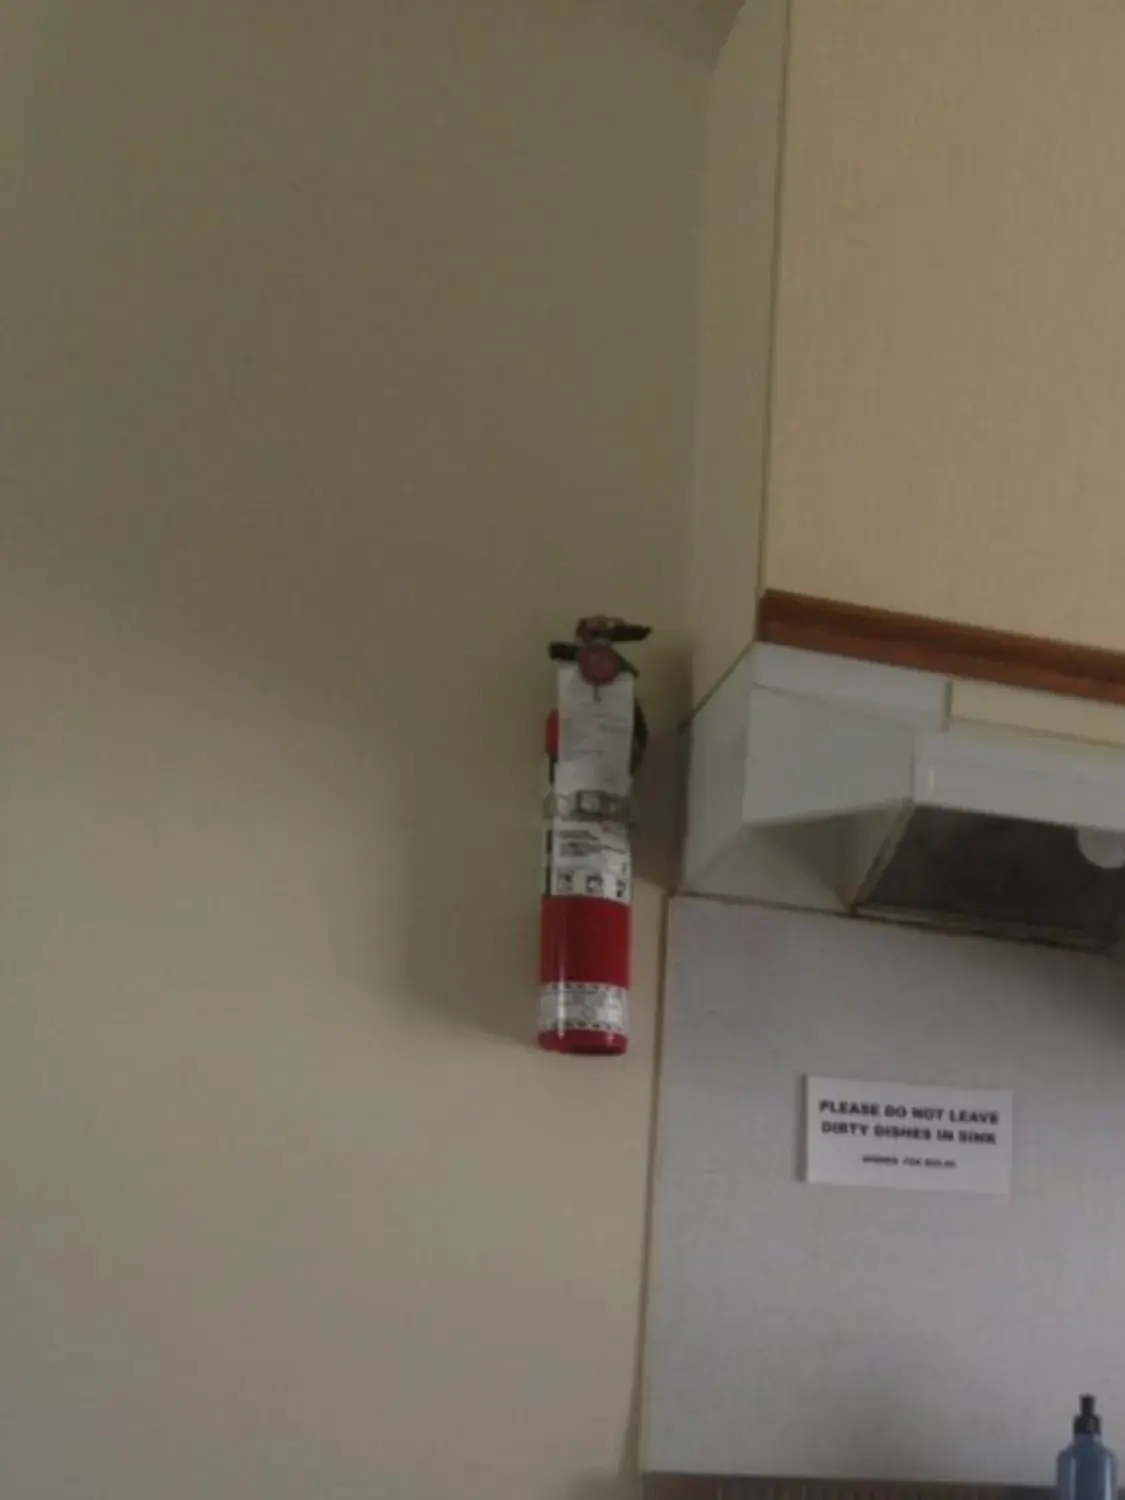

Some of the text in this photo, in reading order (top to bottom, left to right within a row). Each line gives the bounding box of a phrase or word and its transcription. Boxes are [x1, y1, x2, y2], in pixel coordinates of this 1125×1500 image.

[819, 1100, 1000, 1125] PLEASE DO NOT LEAVE
[821, 1121, 997, 1144] DIRTY DISHES IN SINK
